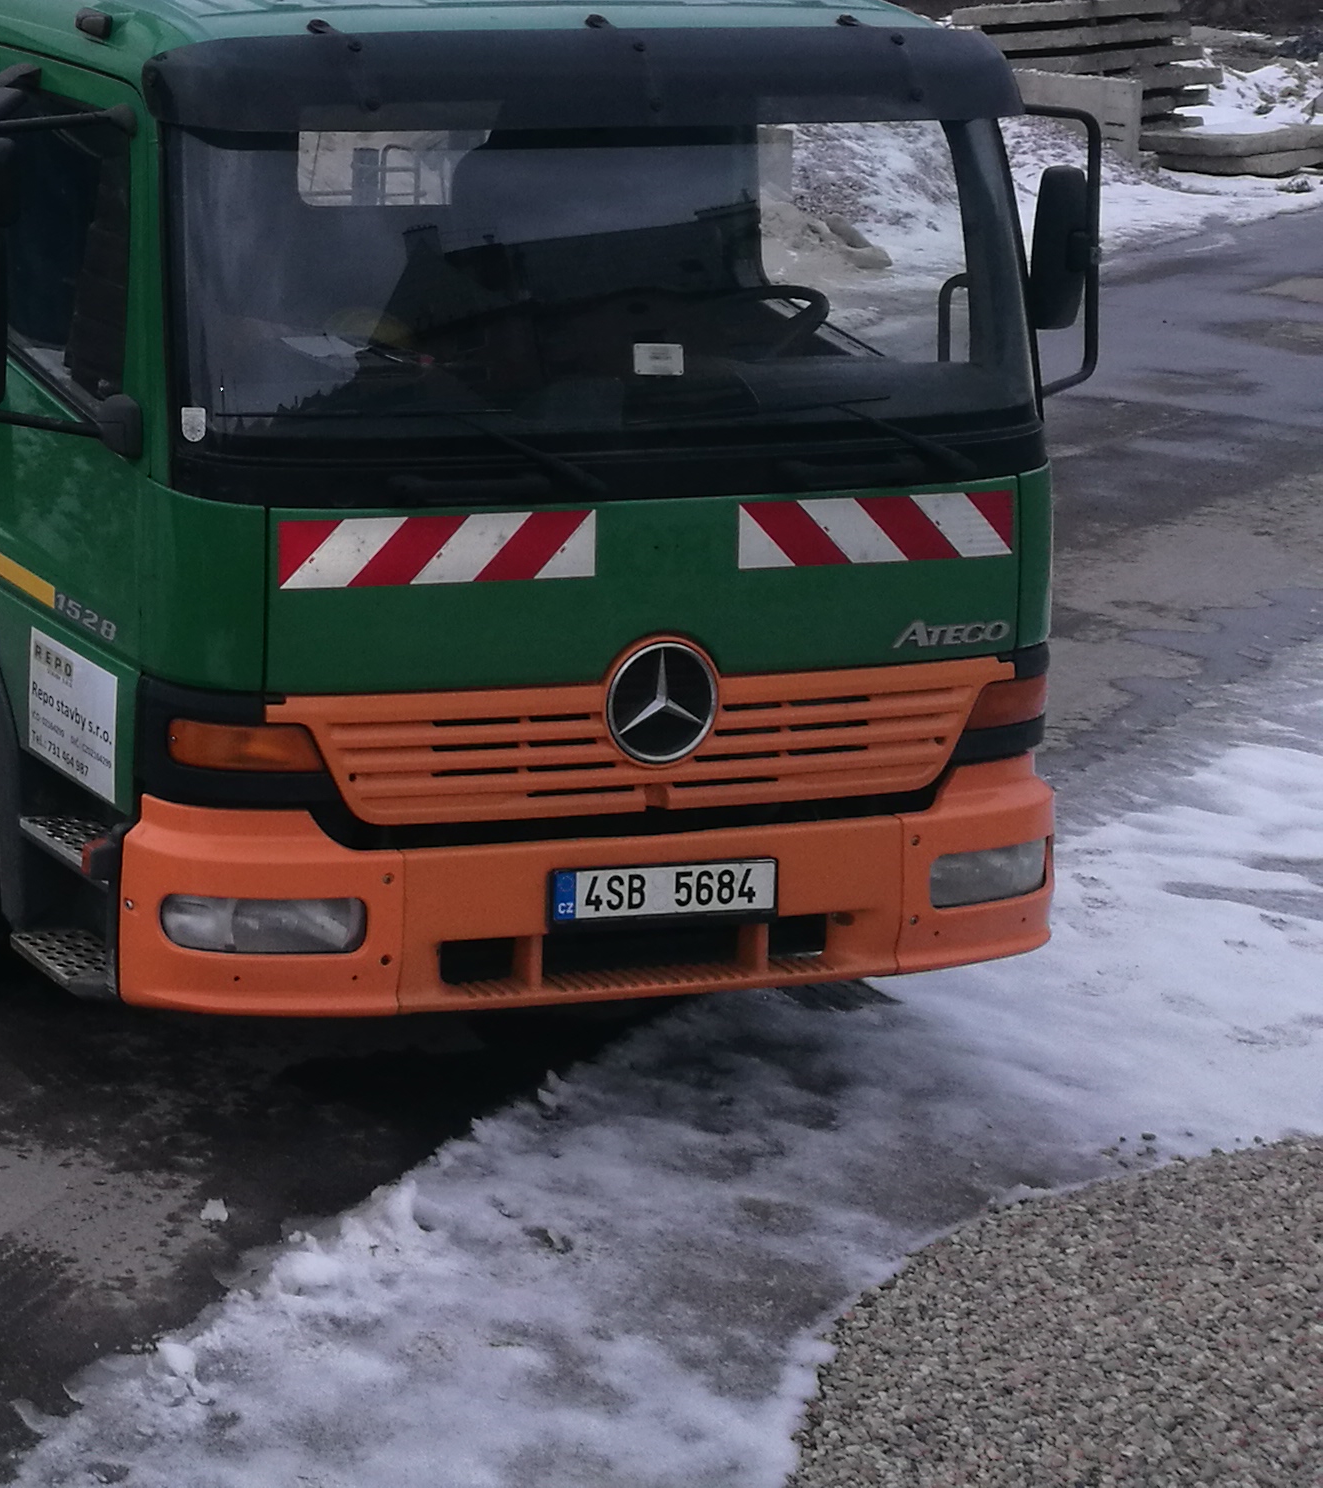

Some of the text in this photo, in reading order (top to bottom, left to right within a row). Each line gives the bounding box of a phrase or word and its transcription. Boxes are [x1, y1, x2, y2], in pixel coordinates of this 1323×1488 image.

[56, 593, 117, 640] 1528
[35, 644, 73, 677] REPO
[32, 681, 112, 745] Repo stavby s.r.o.
[48, 740, 61, 759] 731
[557, 902, 574, 914] CZ
[584, 867, 756, 912] 4SB 5684
